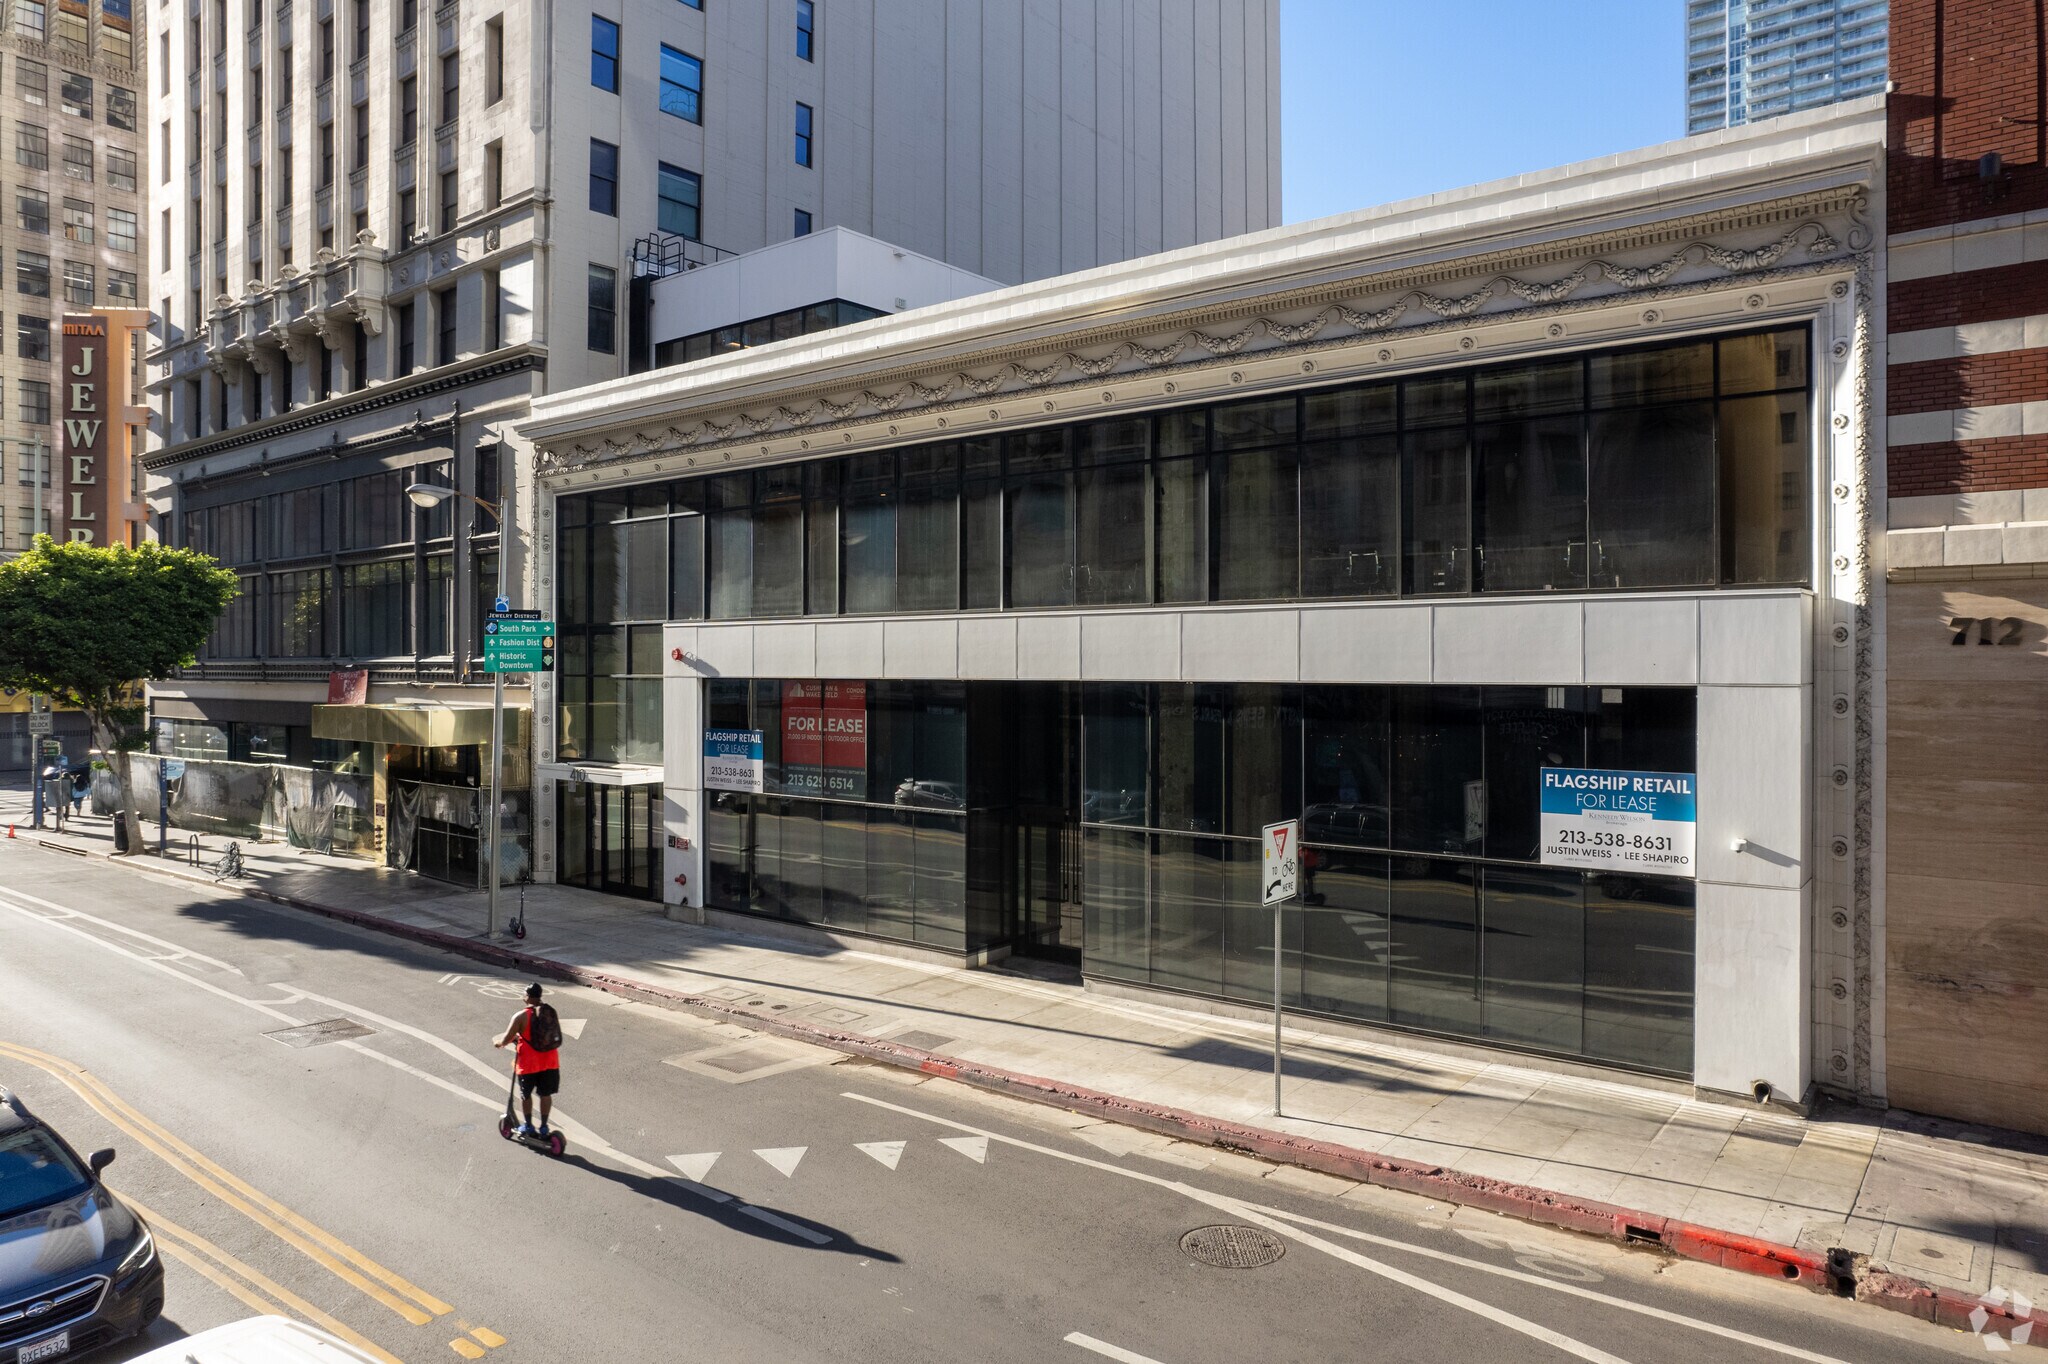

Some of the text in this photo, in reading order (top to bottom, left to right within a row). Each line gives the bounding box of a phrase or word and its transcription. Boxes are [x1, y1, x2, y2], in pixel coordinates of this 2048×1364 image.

[1950, 617, 2023, 646] 712
[500, 652, 526, 660] Historic
[788, 716, 863, 733] FOR LEASE
[705, 731, 761, 744] FLAGSHIP RETAIL
[717, 743, 749, 754] FOR LEASE
[570, 768, 586, 782] 410
[711, 766, 755, 778] 213-538-8631
[788, 774, 804, 786] 213
[829, 777, 854, 790] 6514
[1545, 773, 1691, 794] FLAGSHIP RETAIL
[1576, 793, 1657, 811] FOR LEASE
[1559, 829, 1672, 851] 213-538-8631
[1546, 845, 1689, 865] JUSTIN WEISS LEE SHAPIRO
[1272, 866, 1278, 876] TO
[1283, 882, 1293, 892] HERE
